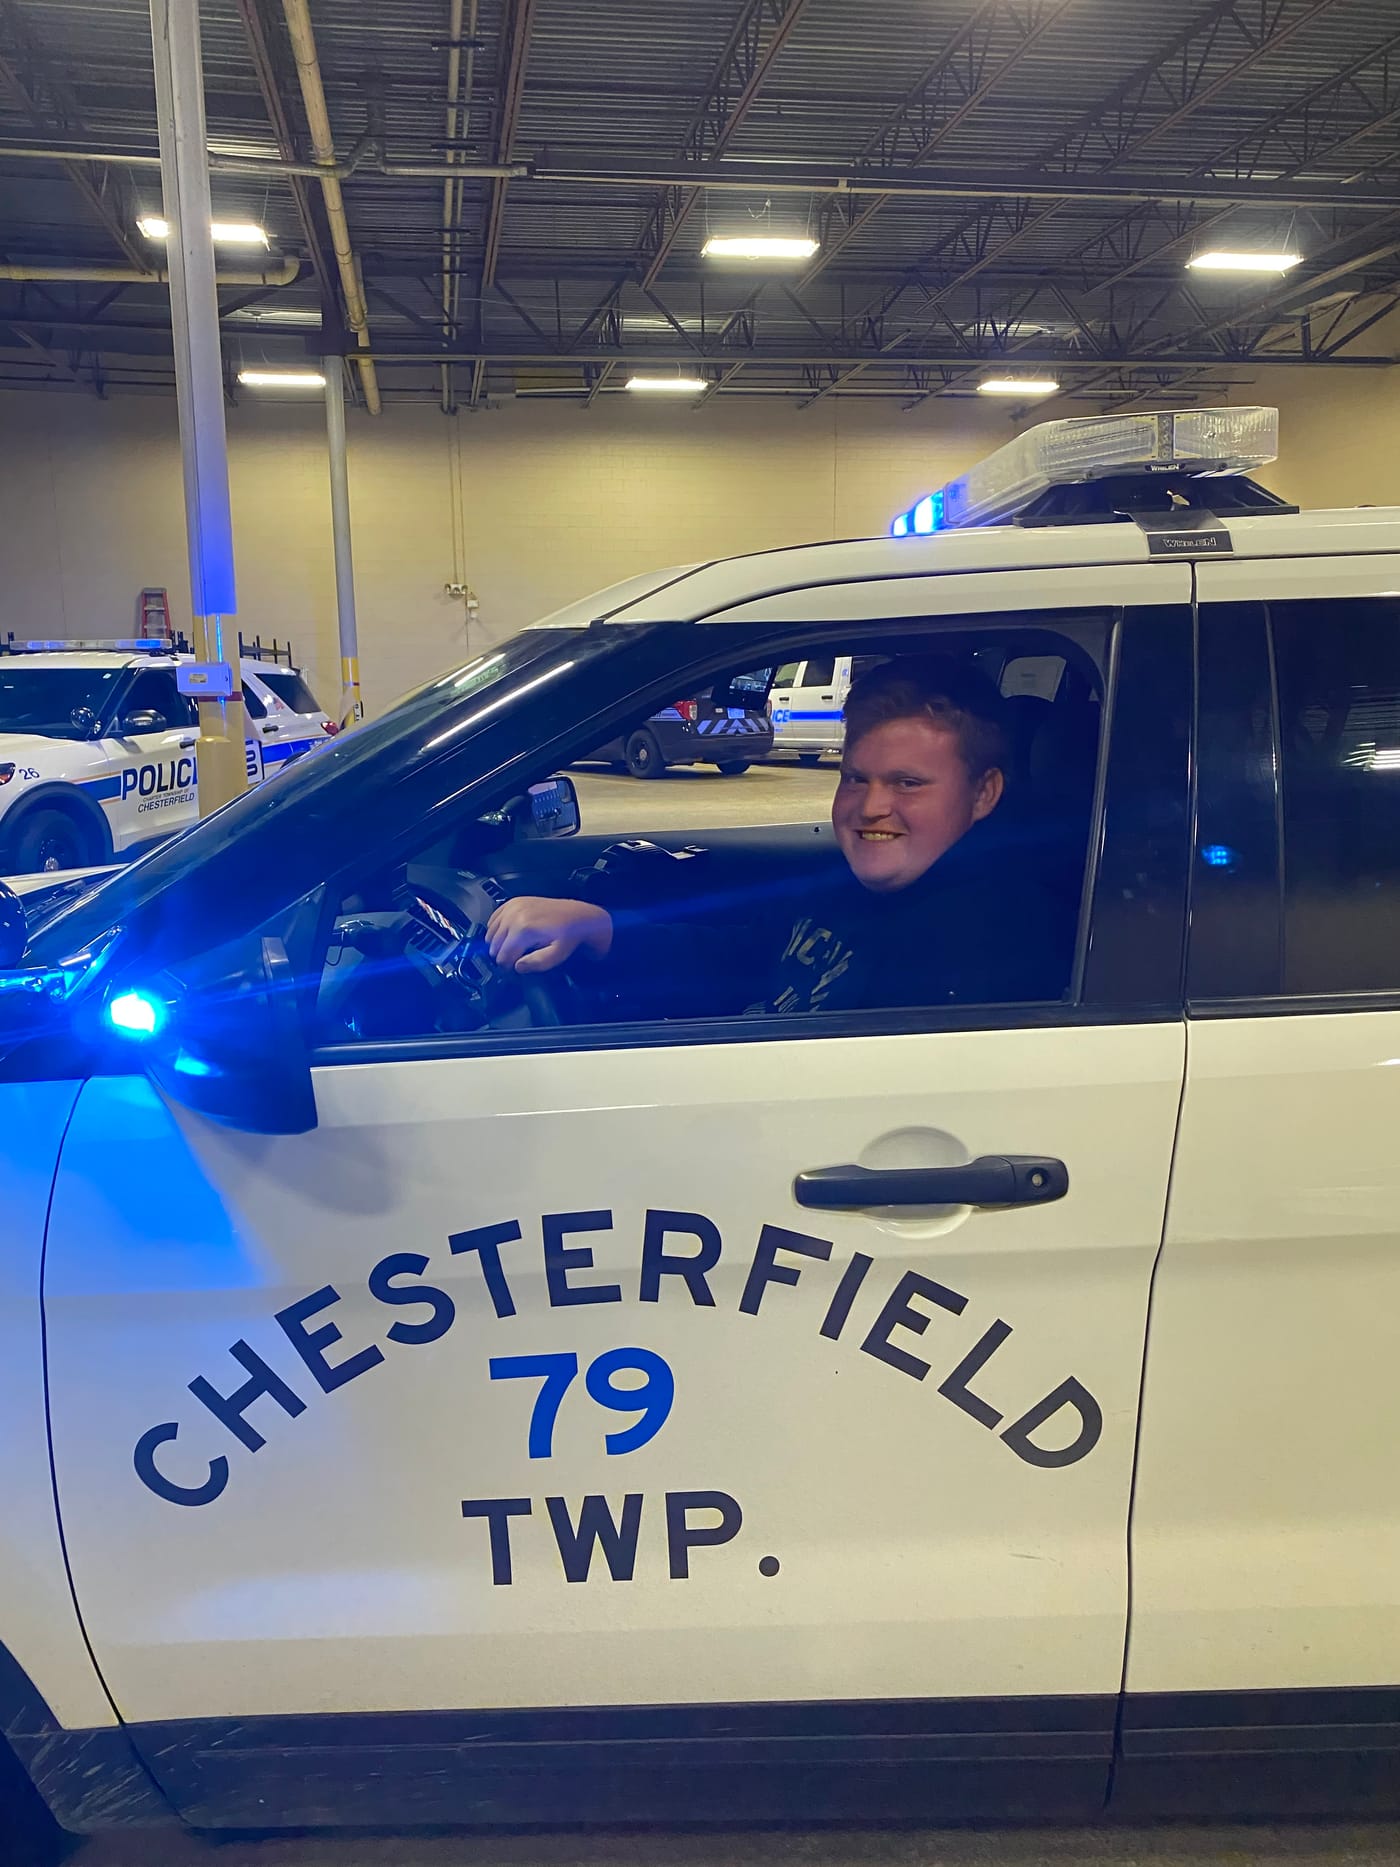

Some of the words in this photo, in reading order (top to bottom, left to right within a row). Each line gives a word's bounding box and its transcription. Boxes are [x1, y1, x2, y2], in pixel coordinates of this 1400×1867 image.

[19, 767, 40, 780] 26
[138, 792, 195, 813] CHESTERFIELD
[133, 1209, 1103, 1507] CHESTERFIELD
[489, 1347, 676, 1460] 79
[461, 1490, 780, 1586] TWP.
